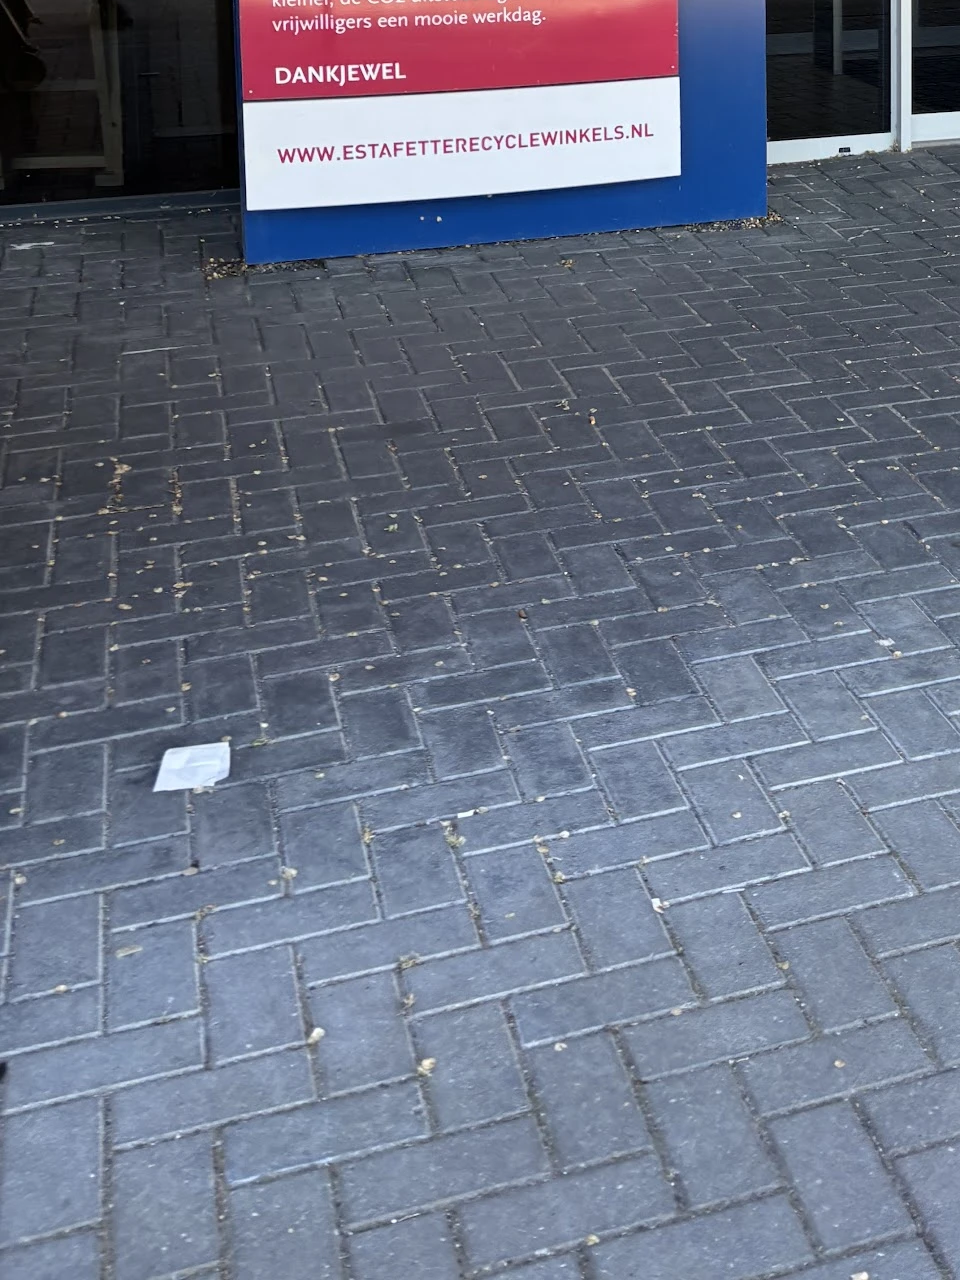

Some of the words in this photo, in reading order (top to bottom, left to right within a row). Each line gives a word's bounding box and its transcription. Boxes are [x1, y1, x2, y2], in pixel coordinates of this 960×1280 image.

[271, 13, 372, 36] vrijwilligers
[377, 15, 408, 28] een
[414, 10, 468, 26] mooie
[472, 7, 547, 26] werkdag.
[275, 62, 406, 87] DANKJEWEL
[277, 123, 654, 164] WWW.ESTAFETTERECYCLEWINKELS.NL
